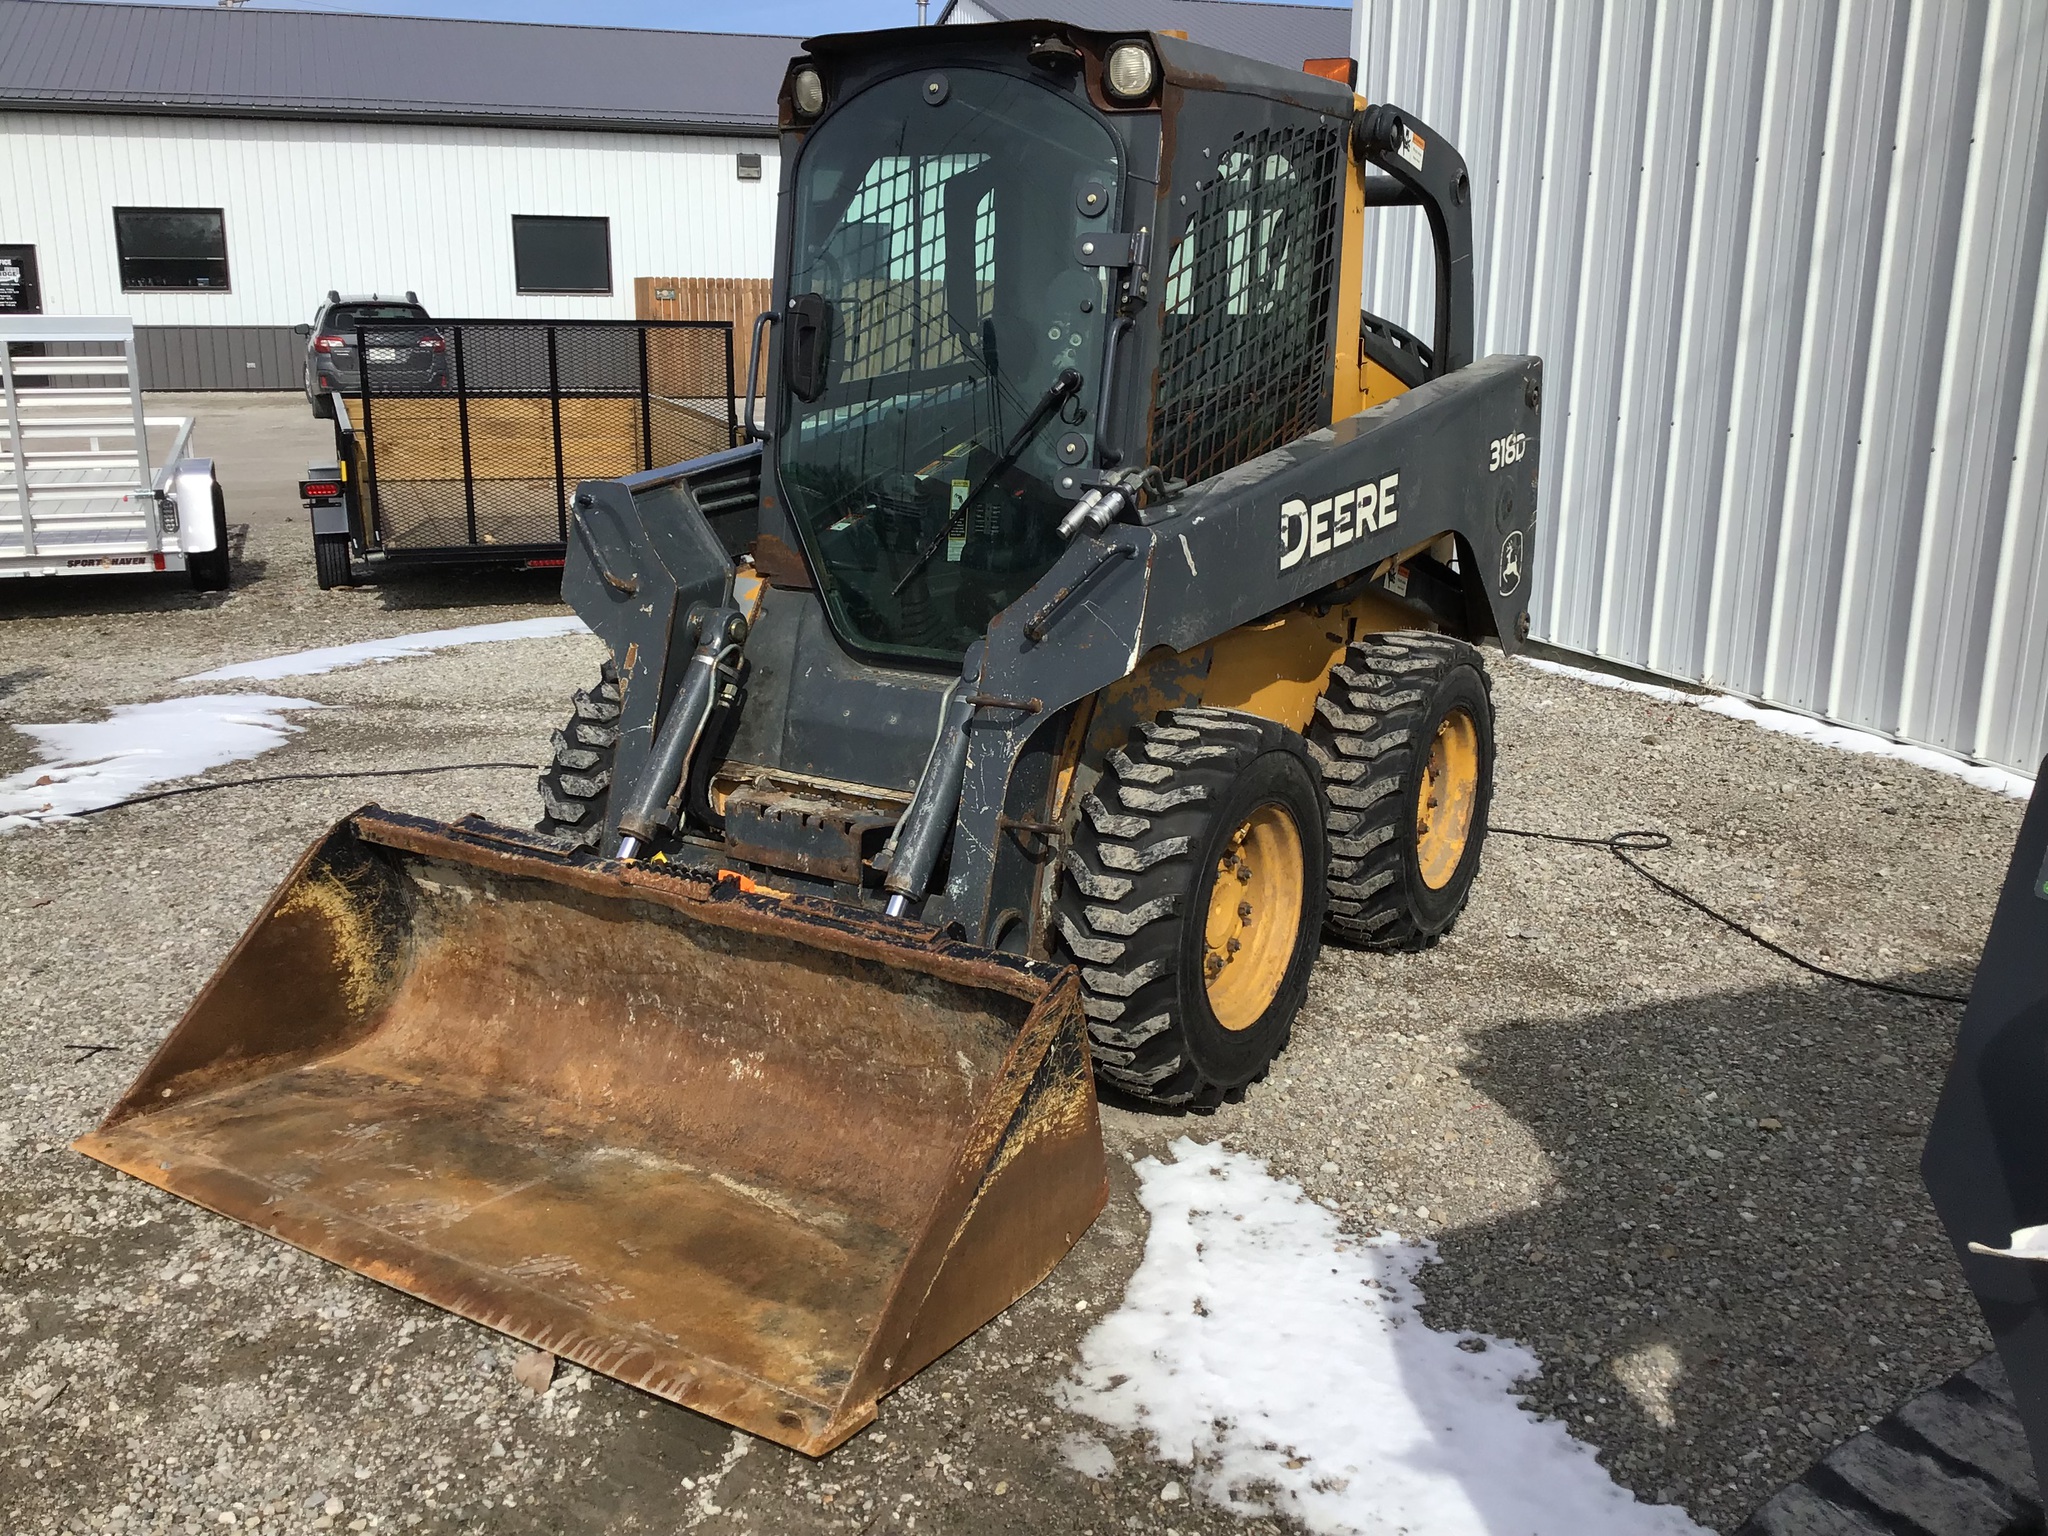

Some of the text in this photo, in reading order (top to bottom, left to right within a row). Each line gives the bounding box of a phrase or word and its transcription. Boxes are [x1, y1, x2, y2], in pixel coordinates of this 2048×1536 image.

[1489, 433, 1526, 471] 318D
[1280, 473, 1399, 570] DEERE
[67, 557, 146, 568] SPORT HAVEN
